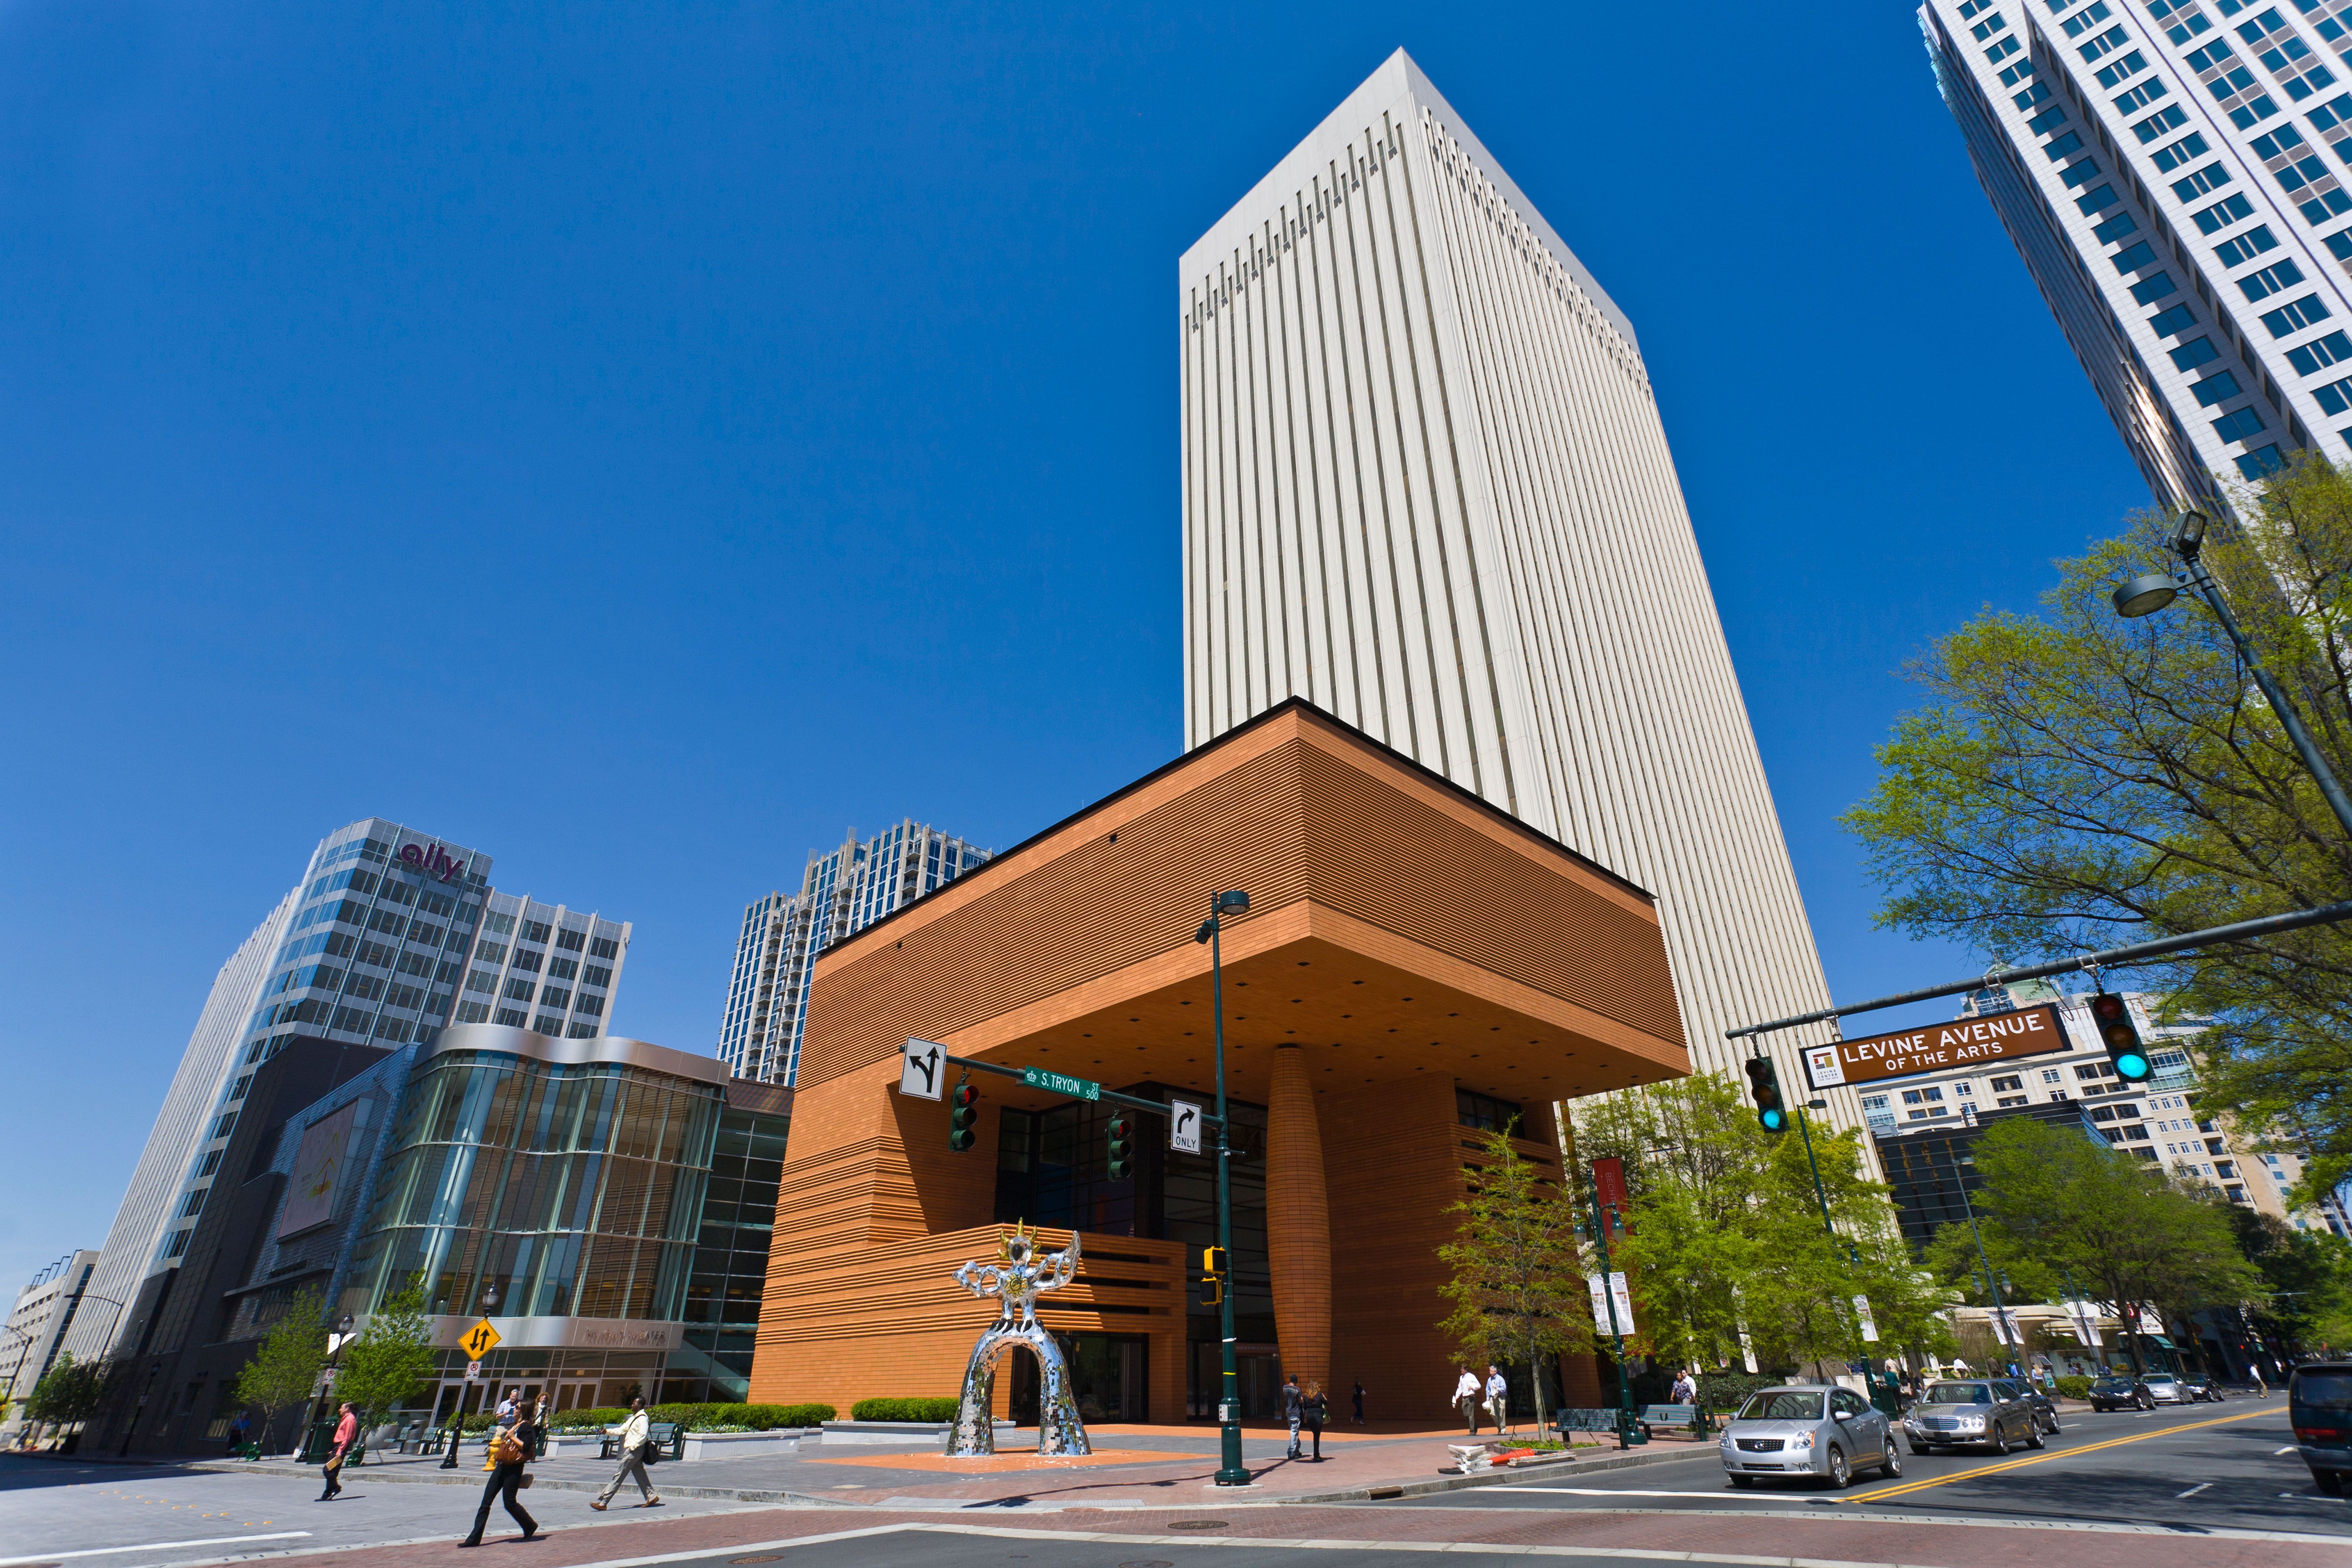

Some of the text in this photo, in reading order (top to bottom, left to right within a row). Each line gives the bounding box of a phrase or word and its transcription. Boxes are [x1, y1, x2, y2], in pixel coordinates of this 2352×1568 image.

[399, 843, 465, 882] ally
[1843, 1013, 2044, 1063] LEVINE AVENUE
[1885, 1042, 2003, 1071] OF THE ARTS
[1051, 1075, 1080, 1094] TRYON
[1092, 1082, 1099, 1092] ST
[1086, 1090, 1098, 1100] 500
[1176, 1136, 1196, 1149] ONLY
